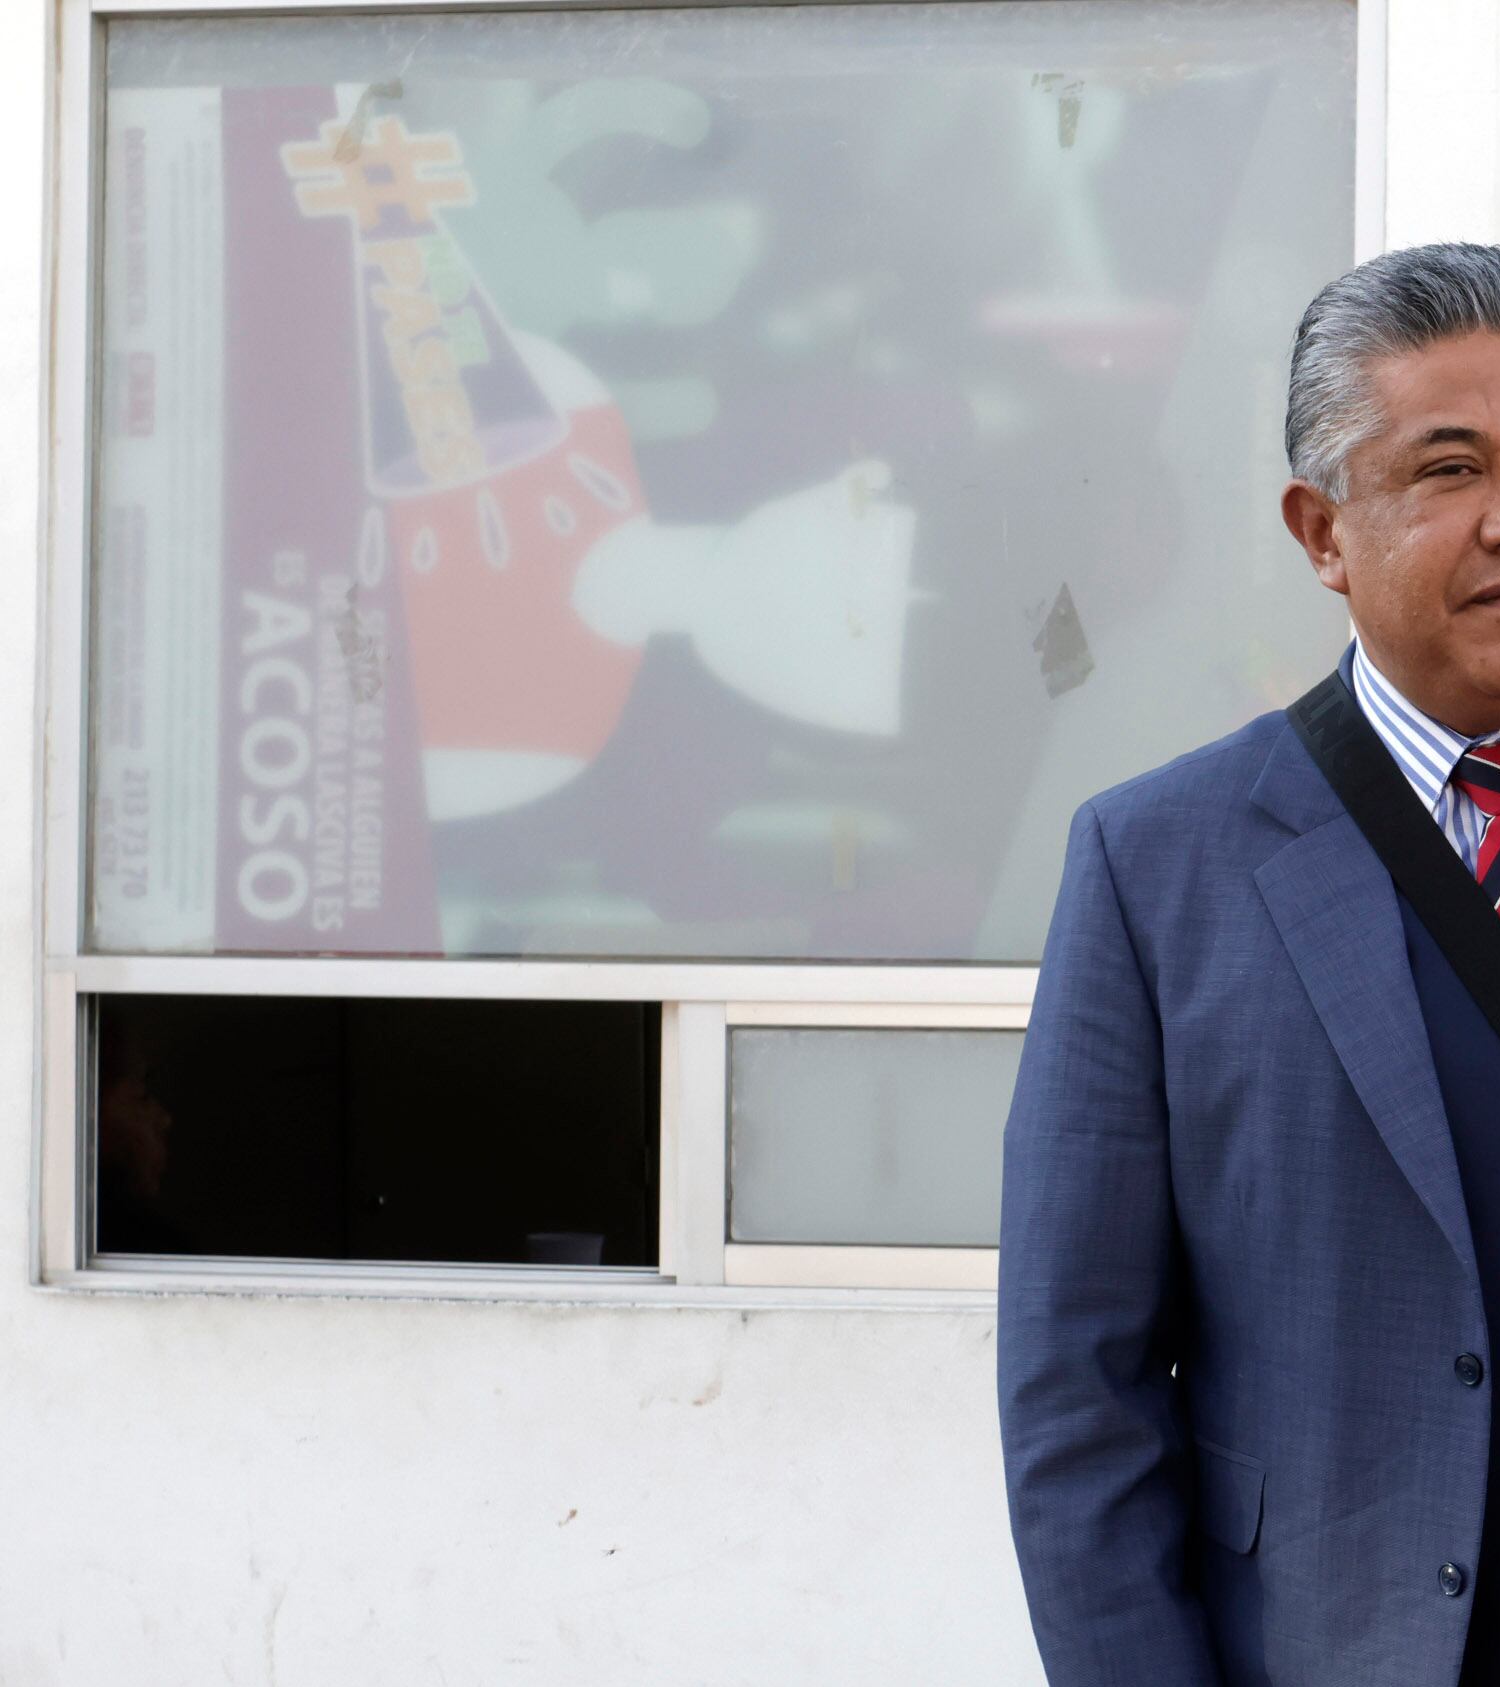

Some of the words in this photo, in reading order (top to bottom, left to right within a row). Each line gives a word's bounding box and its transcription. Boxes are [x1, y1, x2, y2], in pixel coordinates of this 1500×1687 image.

[238, 589, 313, 921] ACOSO
[315, 763, 345, 889] LASCIVA
[349, 775, 383, 910] ALGUIEN
[312, 896, 344, 931] ES
